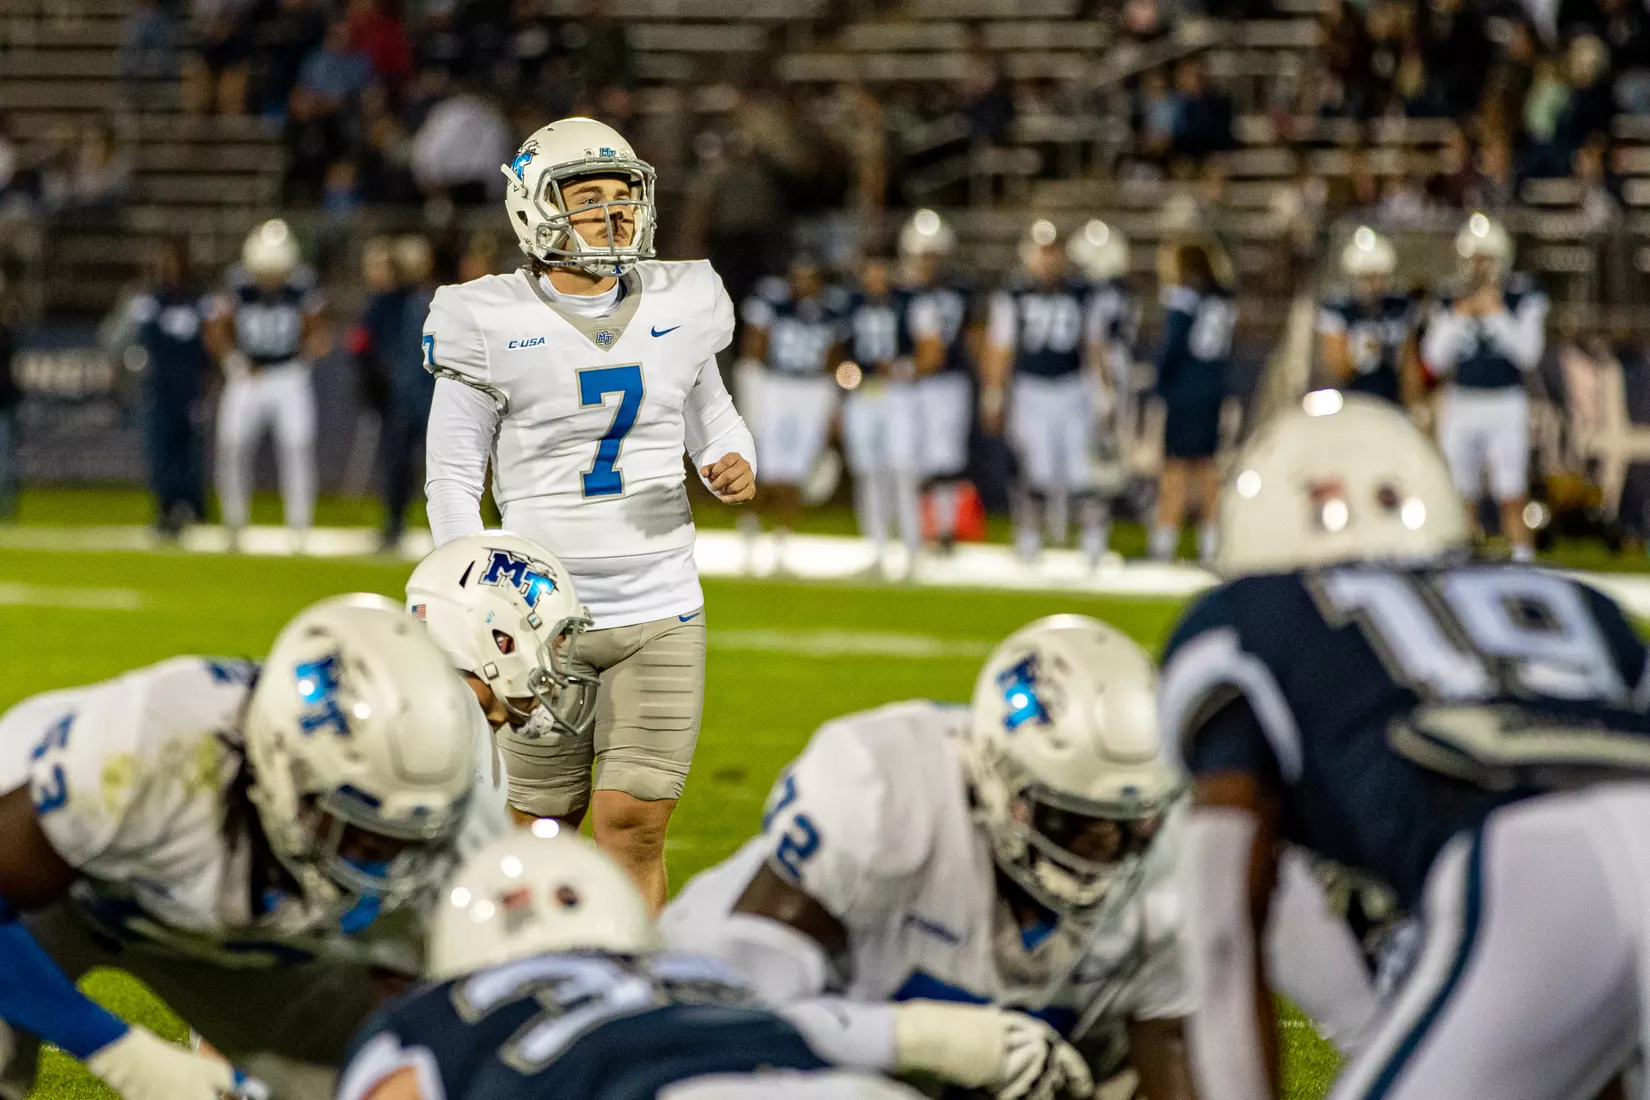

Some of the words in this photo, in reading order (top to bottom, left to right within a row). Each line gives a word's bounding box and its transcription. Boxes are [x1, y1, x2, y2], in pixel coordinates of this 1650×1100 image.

[596, 331, 614, 345] MT
[575, 361, 646, 499] 7
[478, 549, 556, 609] MT
[1304, 565, 1634, 703] 19
